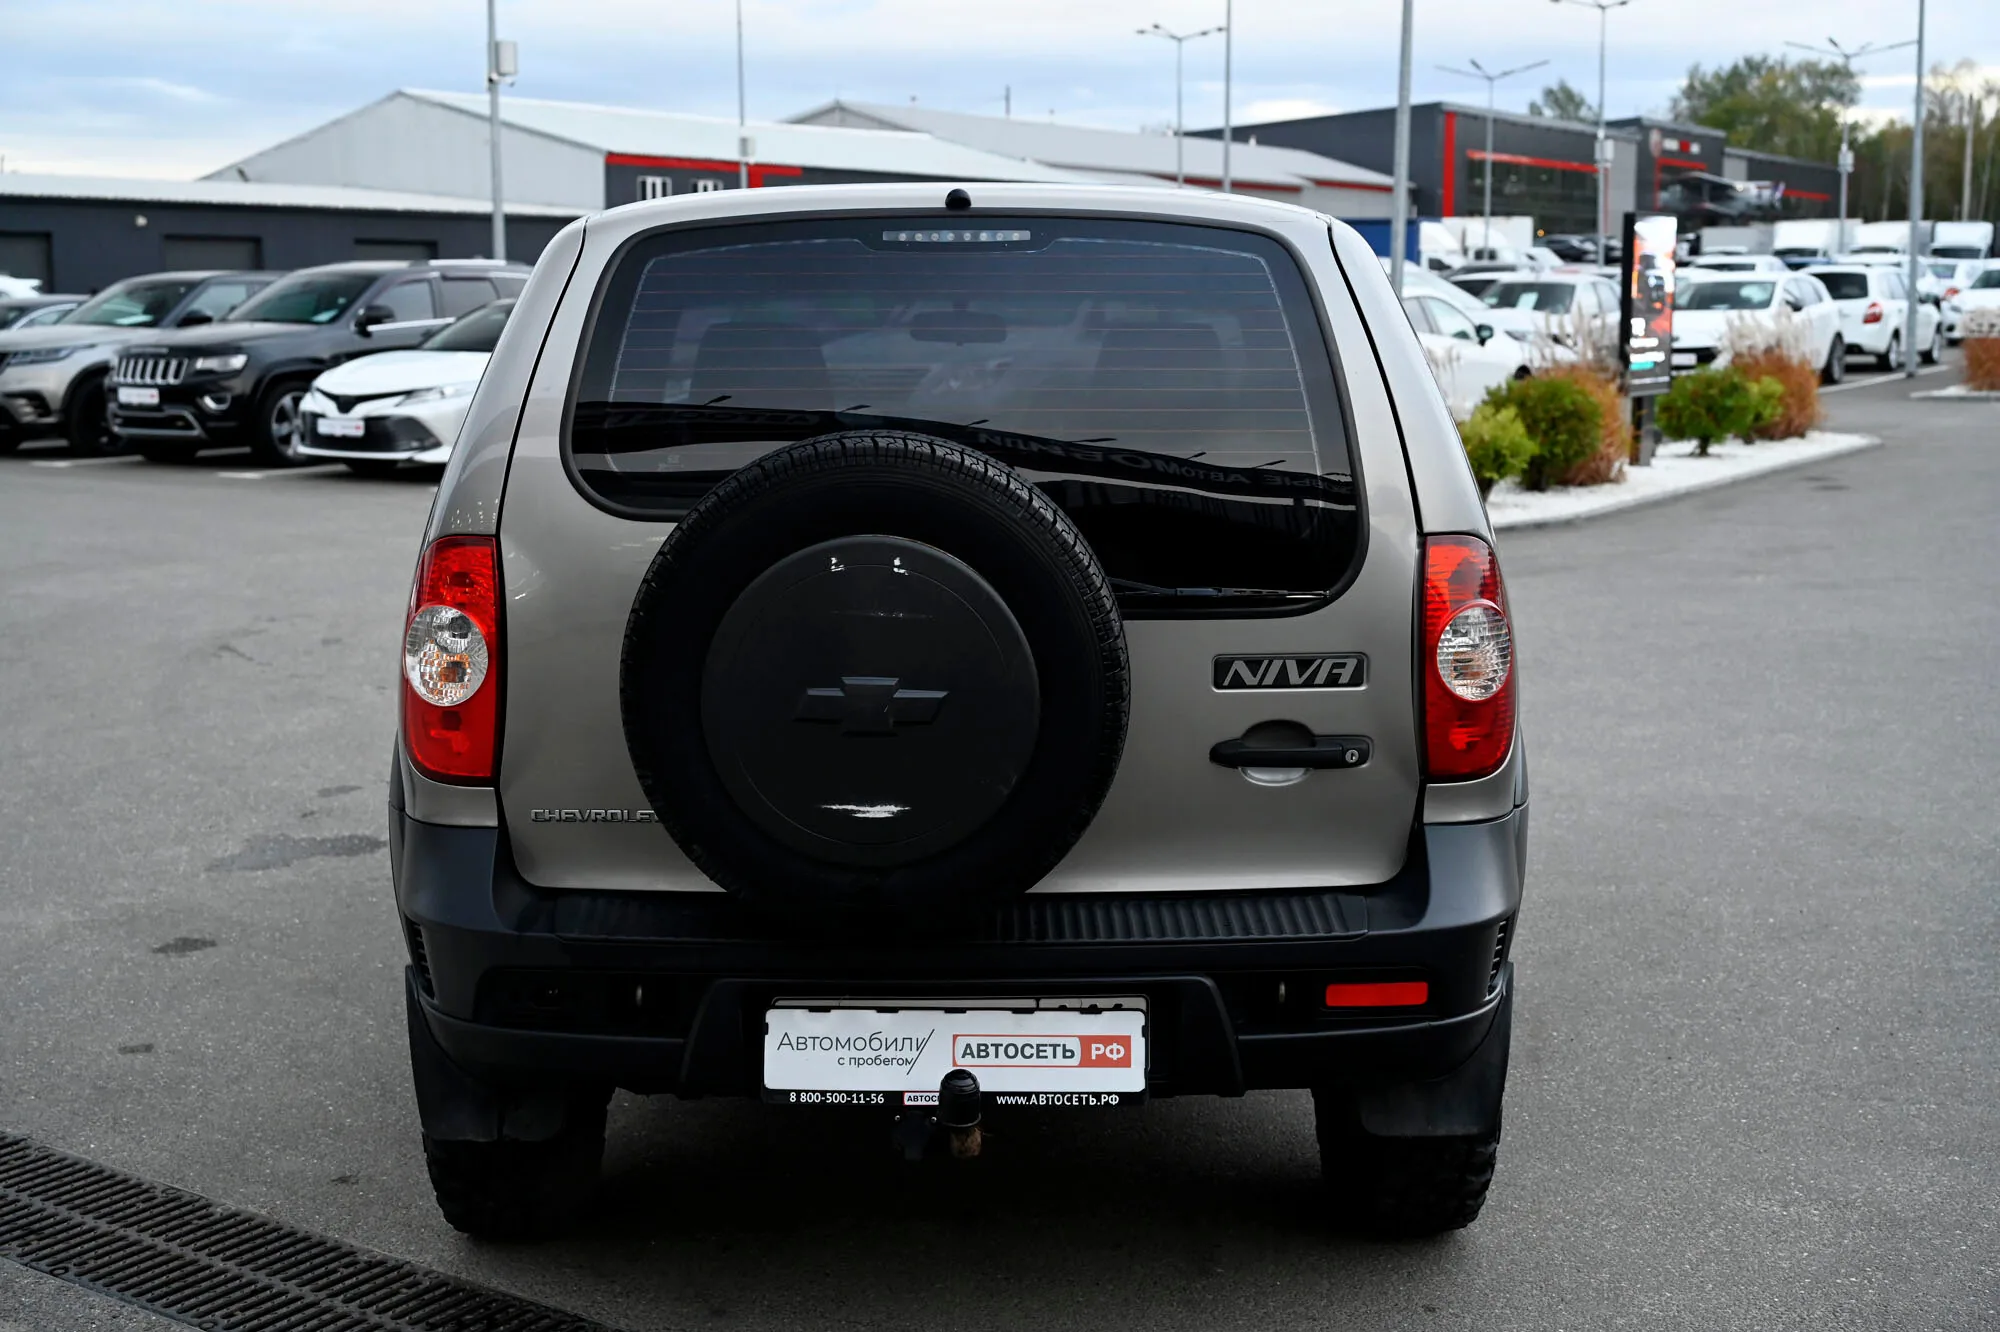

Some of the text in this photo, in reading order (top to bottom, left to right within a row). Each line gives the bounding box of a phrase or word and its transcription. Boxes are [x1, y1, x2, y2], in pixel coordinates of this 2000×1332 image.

[1222, 658, 1358, 686] NIVA
[777, 1031, 927, 1052] Автомобили
[961, 1042, 1126, 1061] АВТОСЕТЬ РФ
[837, 1054, 915, 1068] с пробегом
[789, 1092, 885, 1104] 8 800-500-11-56
[907, 1095, 940, 1103] АВТОС
[996, 1093, 1120, 1106] www.АВТОСЕТЬ.РФ
